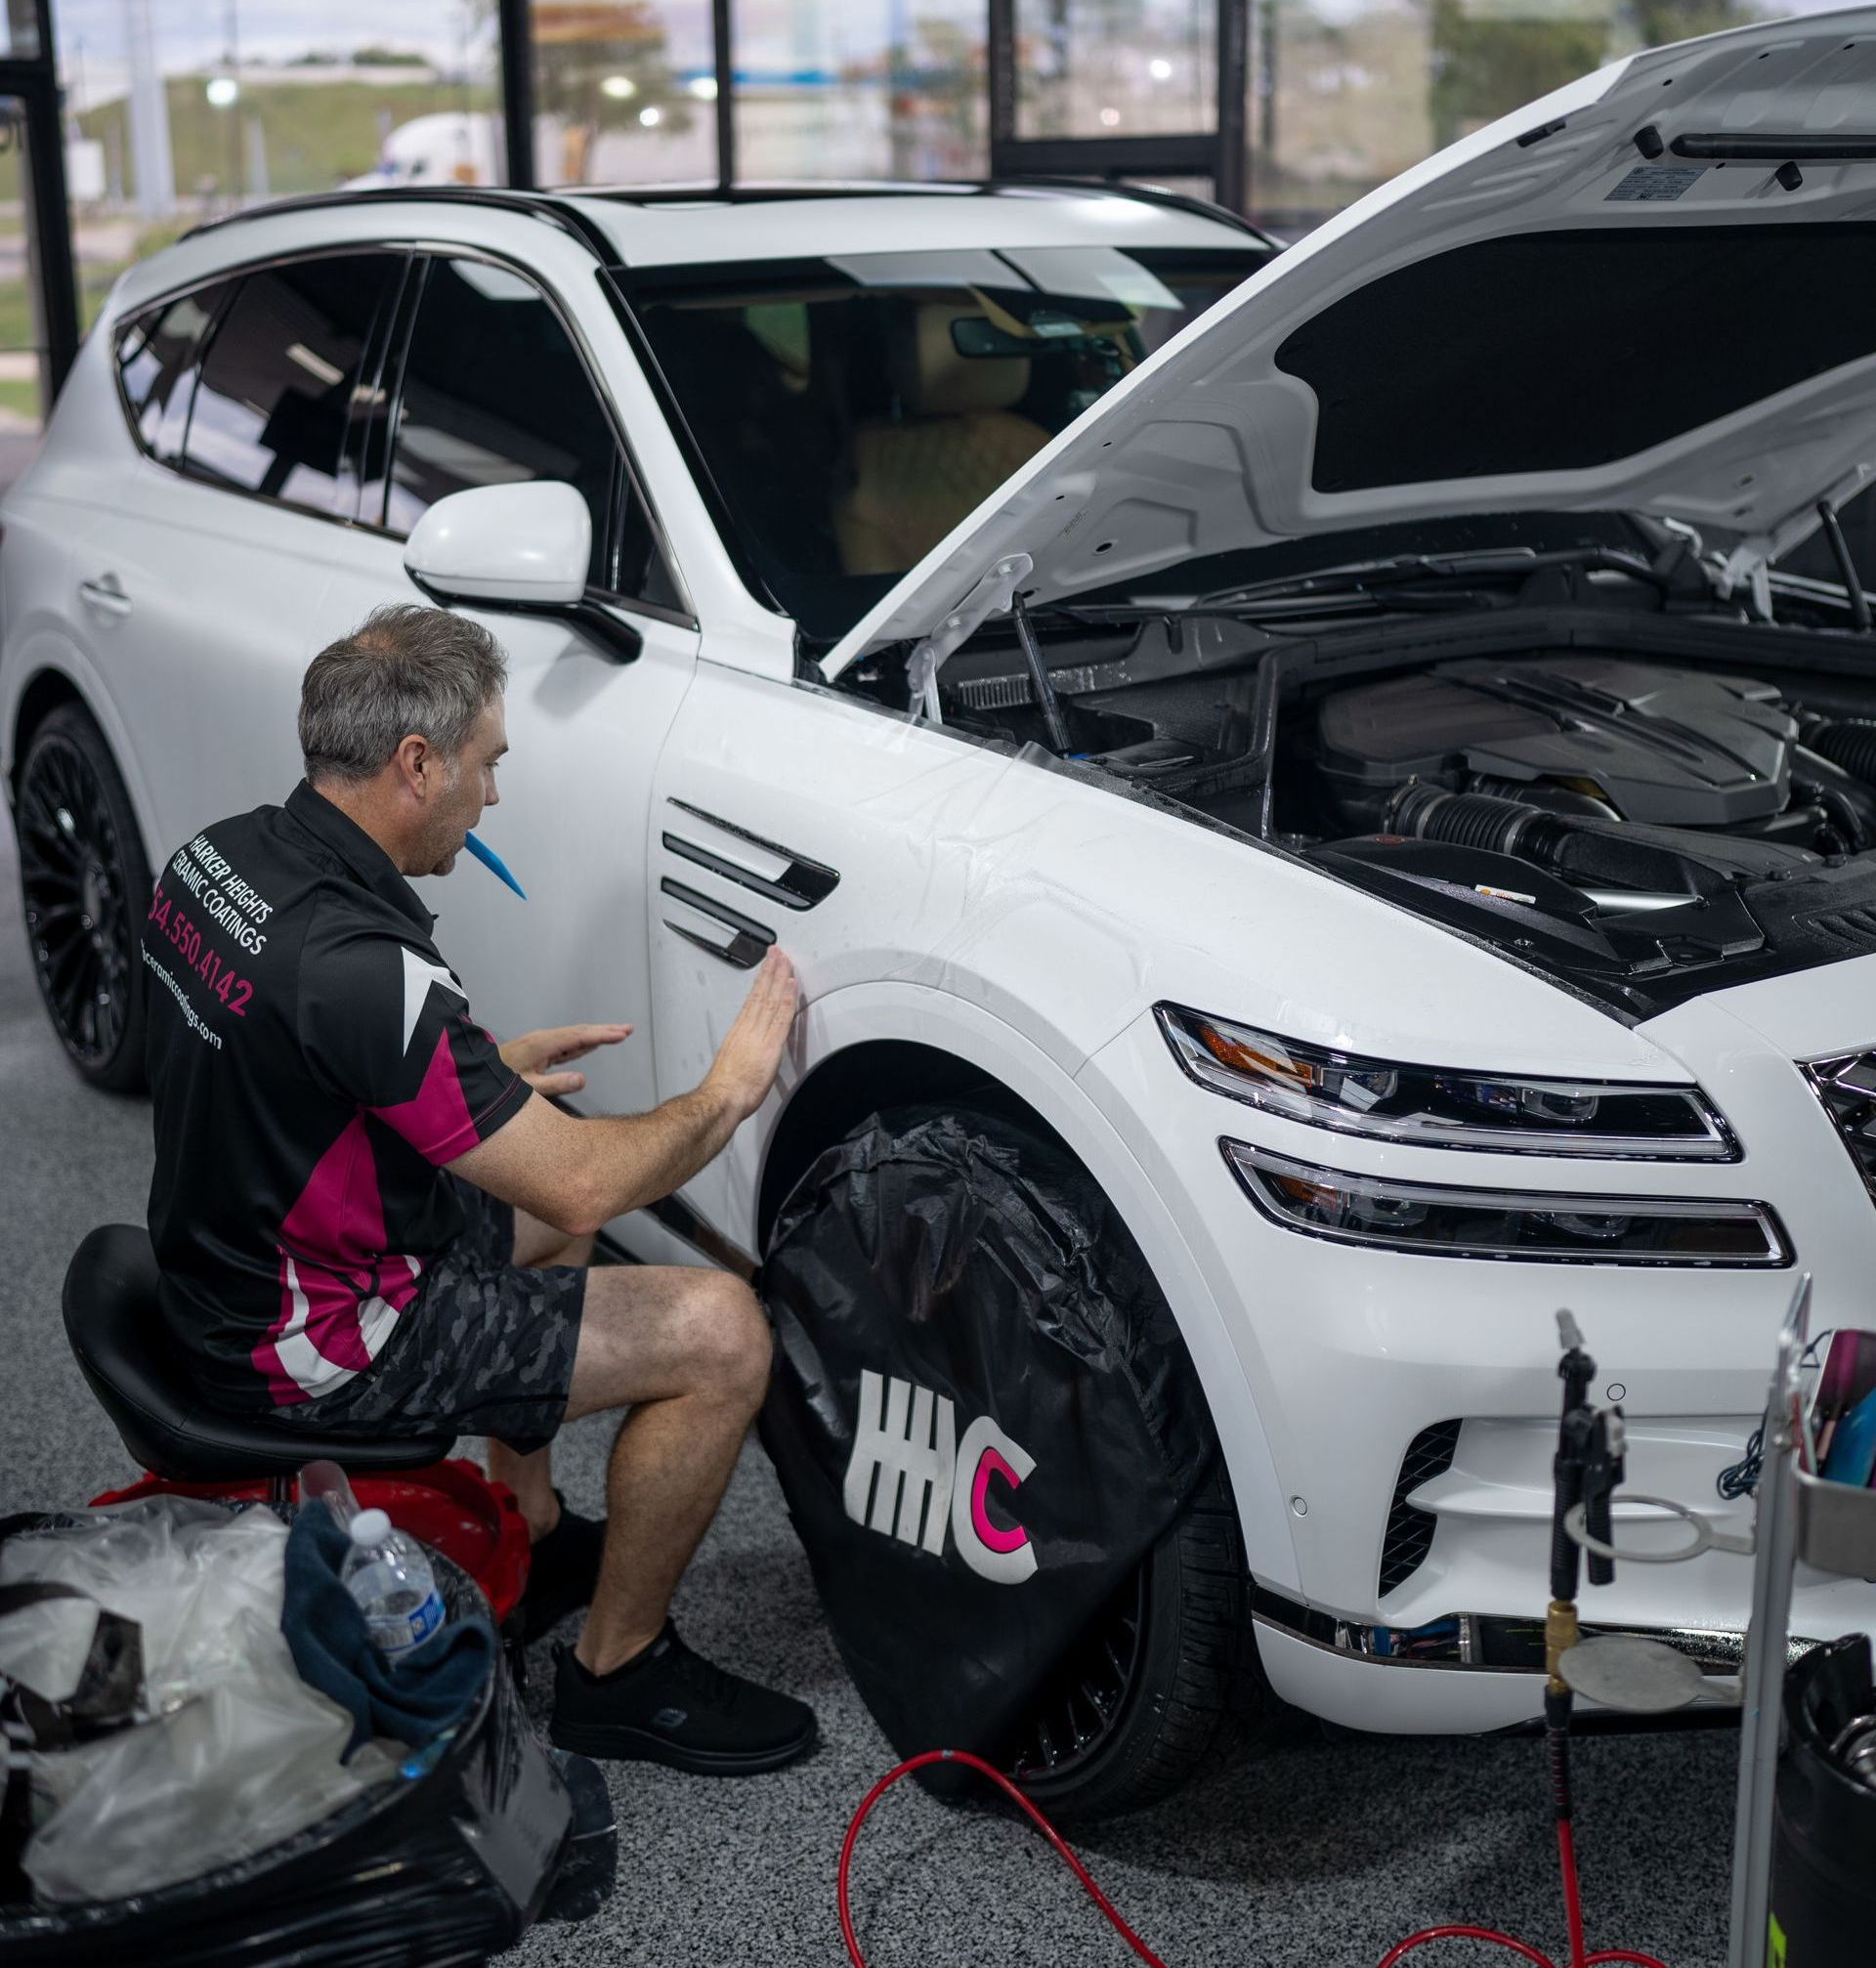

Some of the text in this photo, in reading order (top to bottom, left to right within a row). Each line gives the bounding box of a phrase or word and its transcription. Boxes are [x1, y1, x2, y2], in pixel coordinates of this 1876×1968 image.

[172, 849, 268, 956] CERAMIC COATINGS
[189, 834, 274, 924] HARKER HEIGHTS
